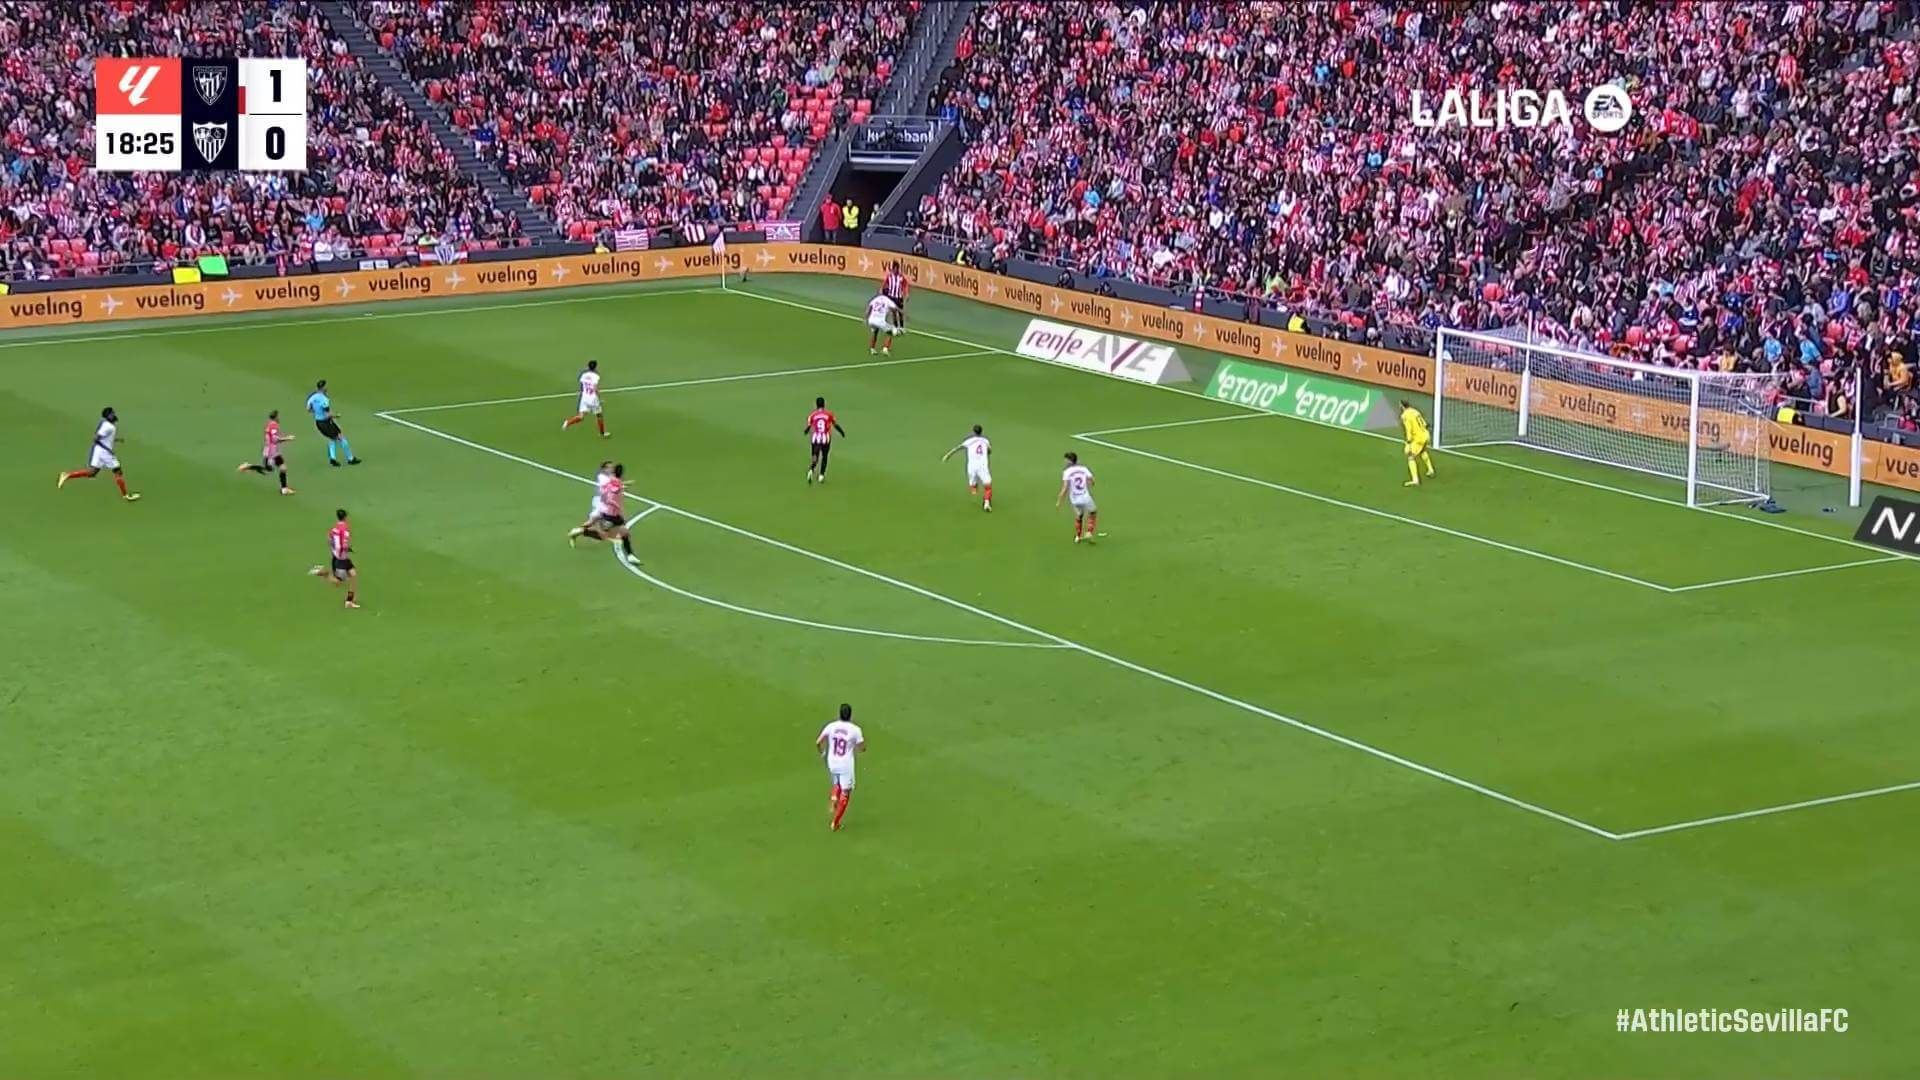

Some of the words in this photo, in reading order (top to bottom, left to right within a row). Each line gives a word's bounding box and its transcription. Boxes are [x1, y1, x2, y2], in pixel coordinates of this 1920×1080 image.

[582, 256, 641, 277] vueling
[788, 247, 847, 270] vueling
[881, 258, 919, 281] vuling
[369, 272, 431, 292] vueling
[477, 265, 538, 286] vueling
[943, 270, 979, 296] vueling
[136, 288, 205, 310] vueling
[255, 281, 321, 301] vueling
[1004, 283, 1042, 311] vueling
[11, 296, 83, 318] vueling
[1071, 297, 1111, 325] vueling
[1142, 311, 1184, 339] vueling
[1026, 328, 1083, 361] renfe
[1083, 335, 1165, 373] AVE
[1216, 327, 1261, 354] vueling
[1295, 341, 1342, 370] vueling
[1377, 356, 1427, 387] vueling
[1465, 374, 1517, 404] vueling
[1559, 392, 1617, 423] vueling
[1660, 411, 1721, 443] vueing
[1769, 431, 1834, 467] vueling
[1073, 477, 1085, 490] 2
[832, 736, 847, 757] 19
